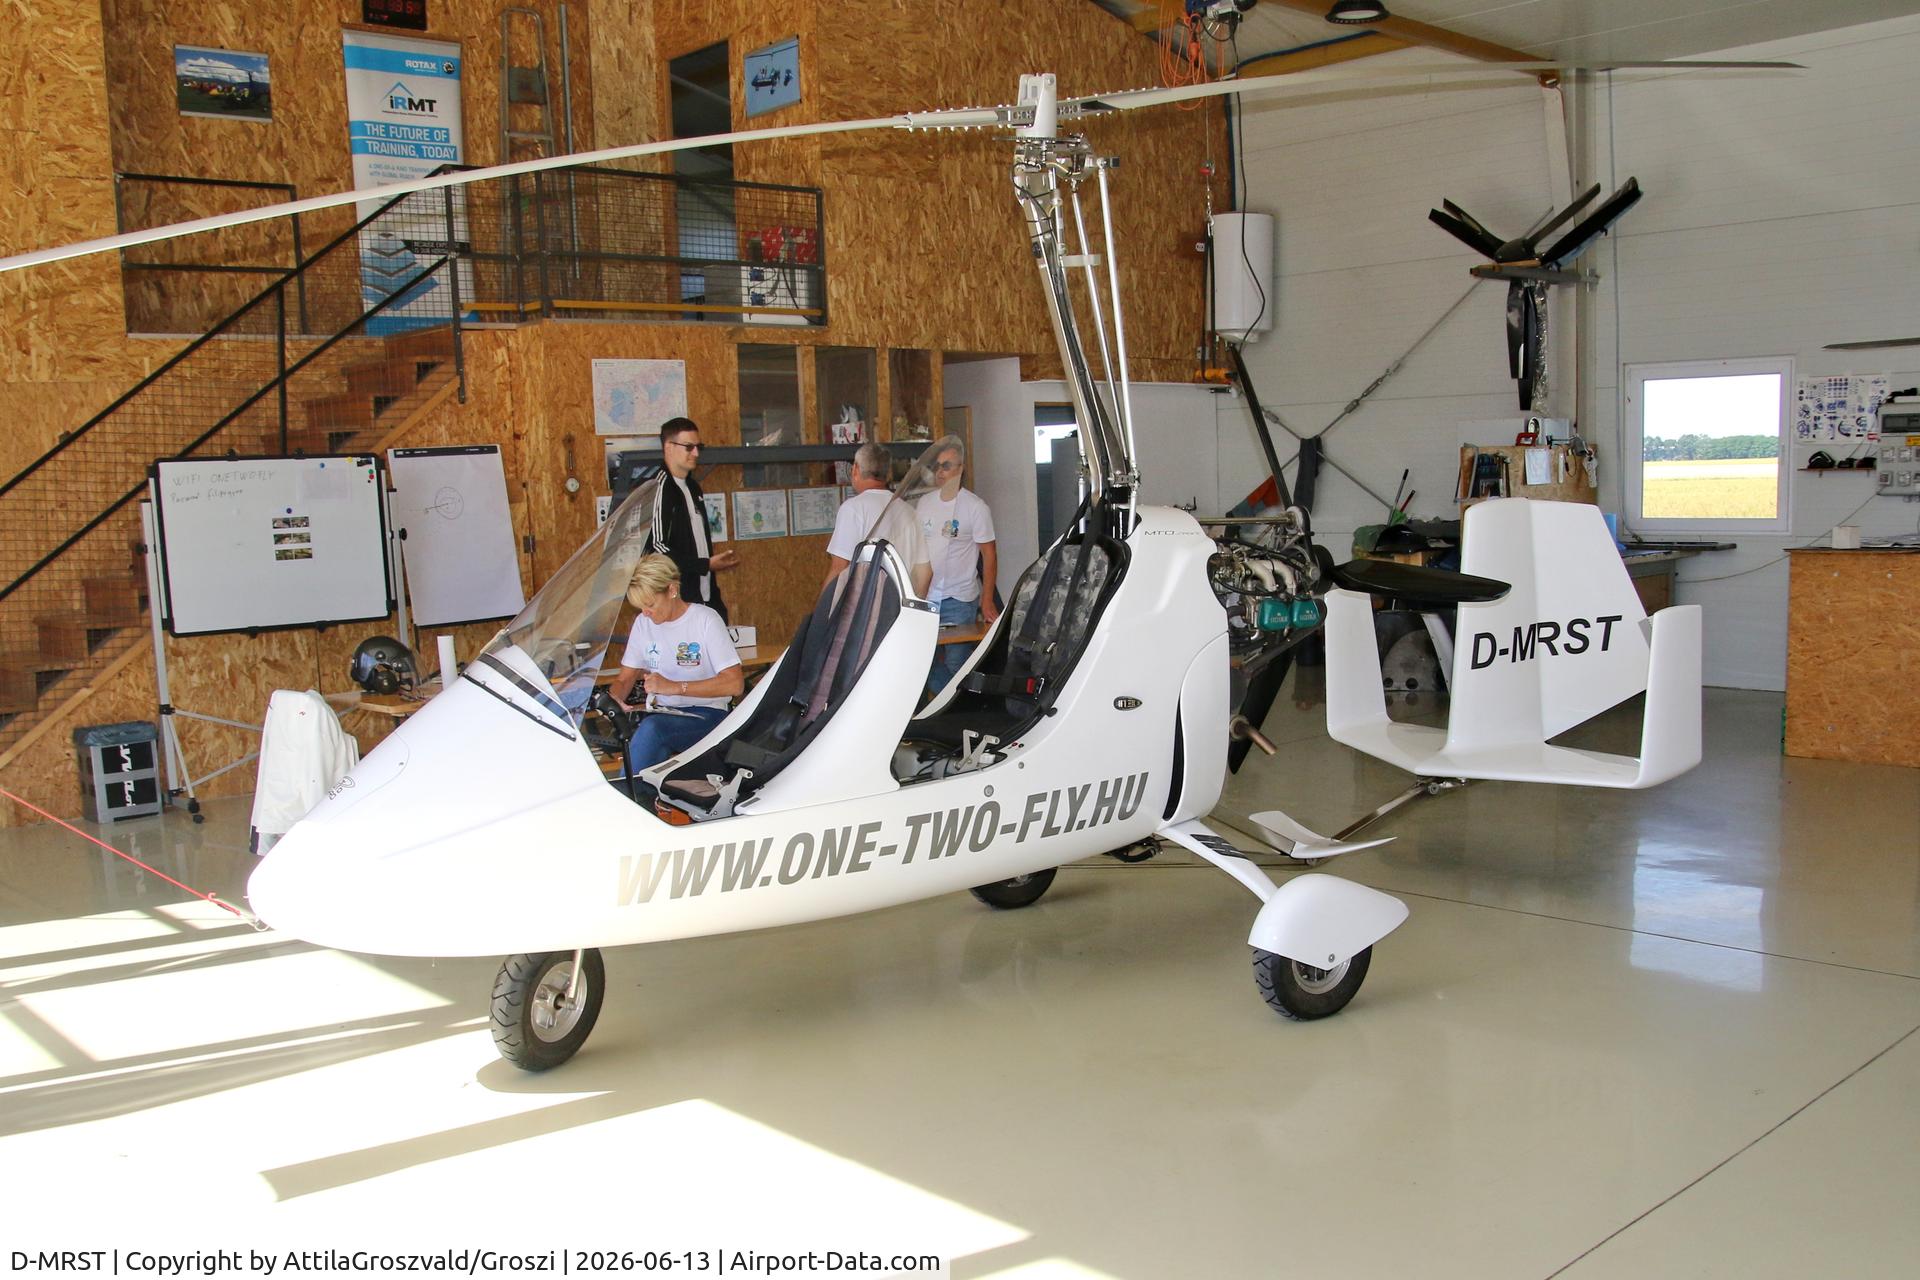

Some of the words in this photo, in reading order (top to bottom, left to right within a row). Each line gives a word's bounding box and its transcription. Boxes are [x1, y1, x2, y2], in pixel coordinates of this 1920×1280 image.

[405, 59, 437, 70] ROTAX
[364, 122, 386, 137] THE
[389, 126, 430, 141] FUTURE
[433, 129, 448, 142] OF
[366, 140, 419, 158] TRAINING,
[421, 145, 456, 159] TODAY
[1470, 614, 1623, 670] D-MRST
[617, 771, 1150, 907] WWW.ONE-TWO-FLY.HU
